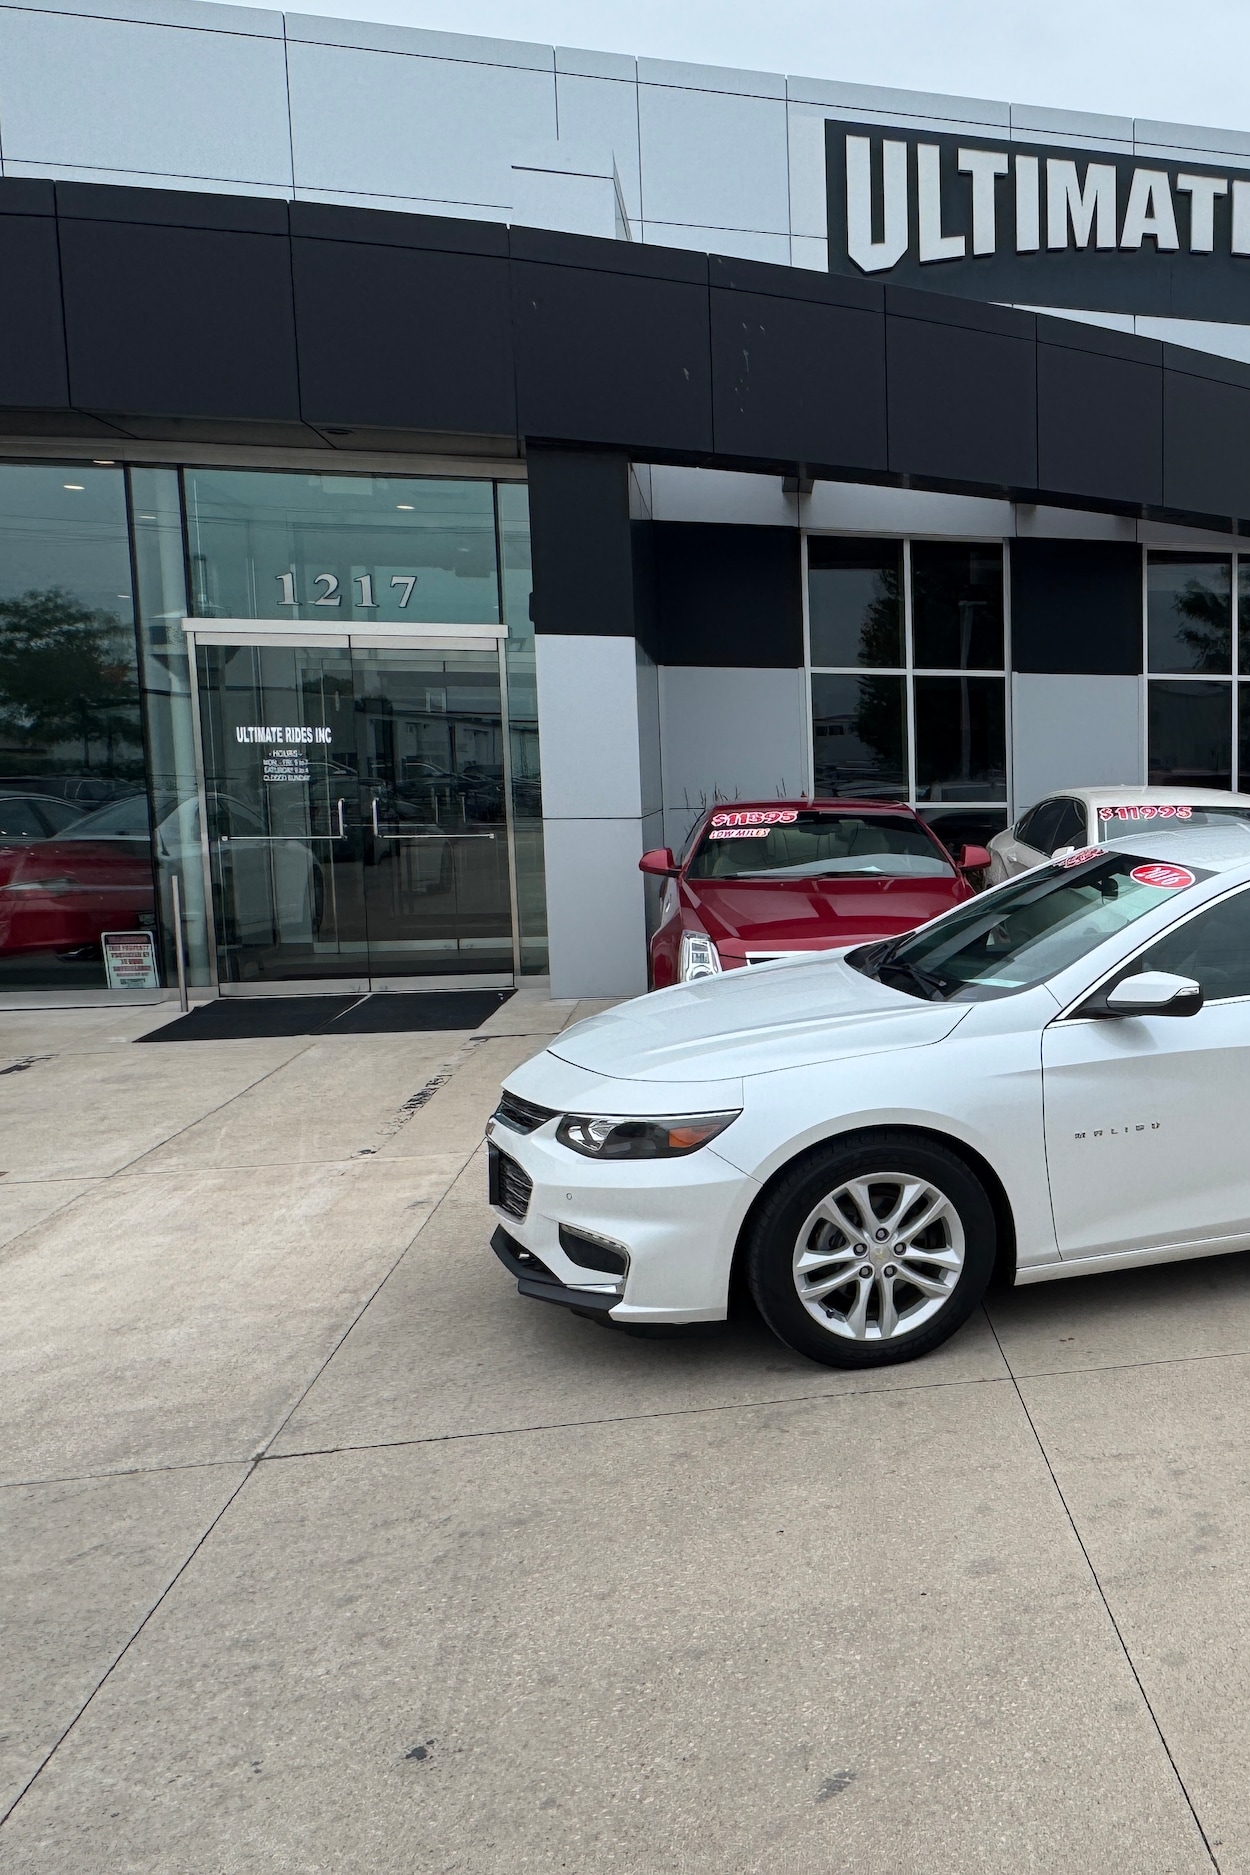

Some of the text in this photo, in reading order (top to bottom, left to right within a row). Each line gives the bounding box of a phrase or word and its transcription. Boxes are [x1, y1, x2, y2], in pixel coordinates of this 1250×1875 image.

[275, 572, 417, 609] 1217
[236, 727, 332, 743] ULTIMATE RIDES INC
[1100, 807, 1193, 821] $11995
[1074, 1122, 1160, 1139] MALIBU
